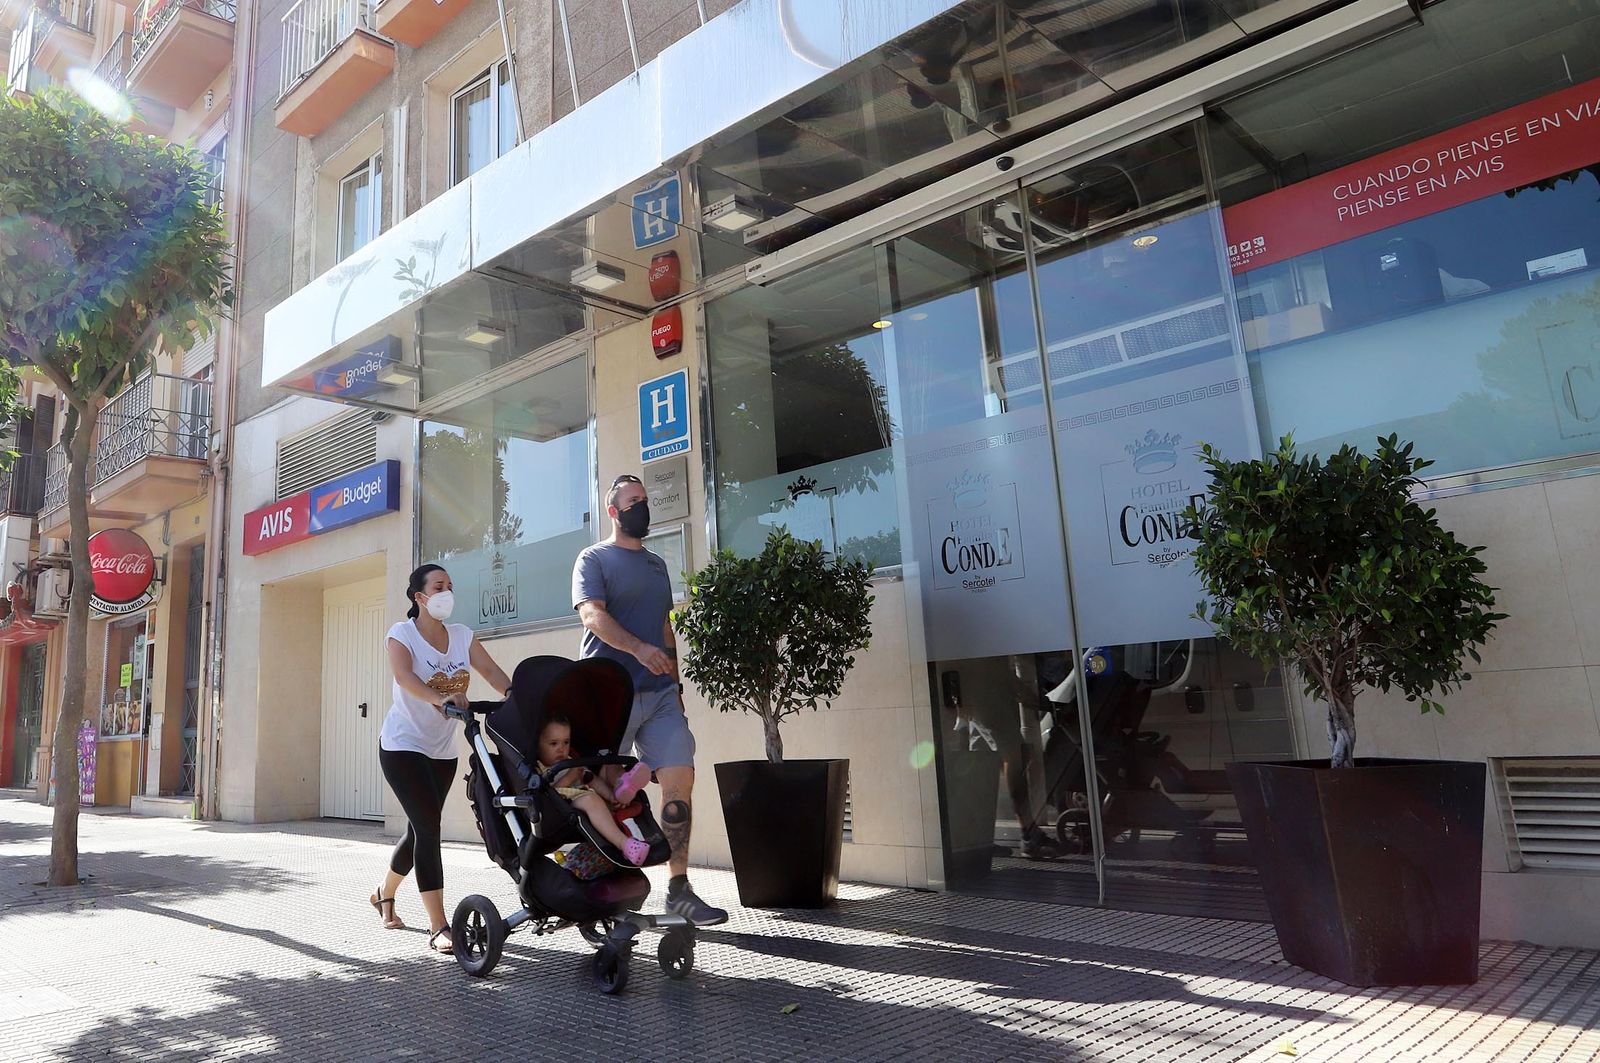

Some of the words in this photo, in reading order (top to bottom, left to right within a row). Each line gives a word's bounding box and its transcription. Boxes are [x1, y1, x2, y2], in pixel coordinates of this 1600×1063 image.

[1333, 158, 1431, 200] CUANDO
[1437, 126, 1520, 166] PIENSE
[1526, 112, 1561, 137] EN
[1337, 186, 1411, 221] PIENSE
[1416, 174, 1447, 196] EN
[1453, 155, 1505, 184] AVIS
[652, 324, 671, 337] FUEGO
[650, 384, 677, 428] H
[648, 442, 683, 459] CIUDAD
[343, 476, 382, 505] Budget
[653, 493, 680, 507] Comfort
[1131, 479, 1190, 500] HOTEL
[258, 507, 293, 541] AVIS
[962, 576, 996, 589] Sercotel
[120, 599, 146, 612] ALAMEDA
